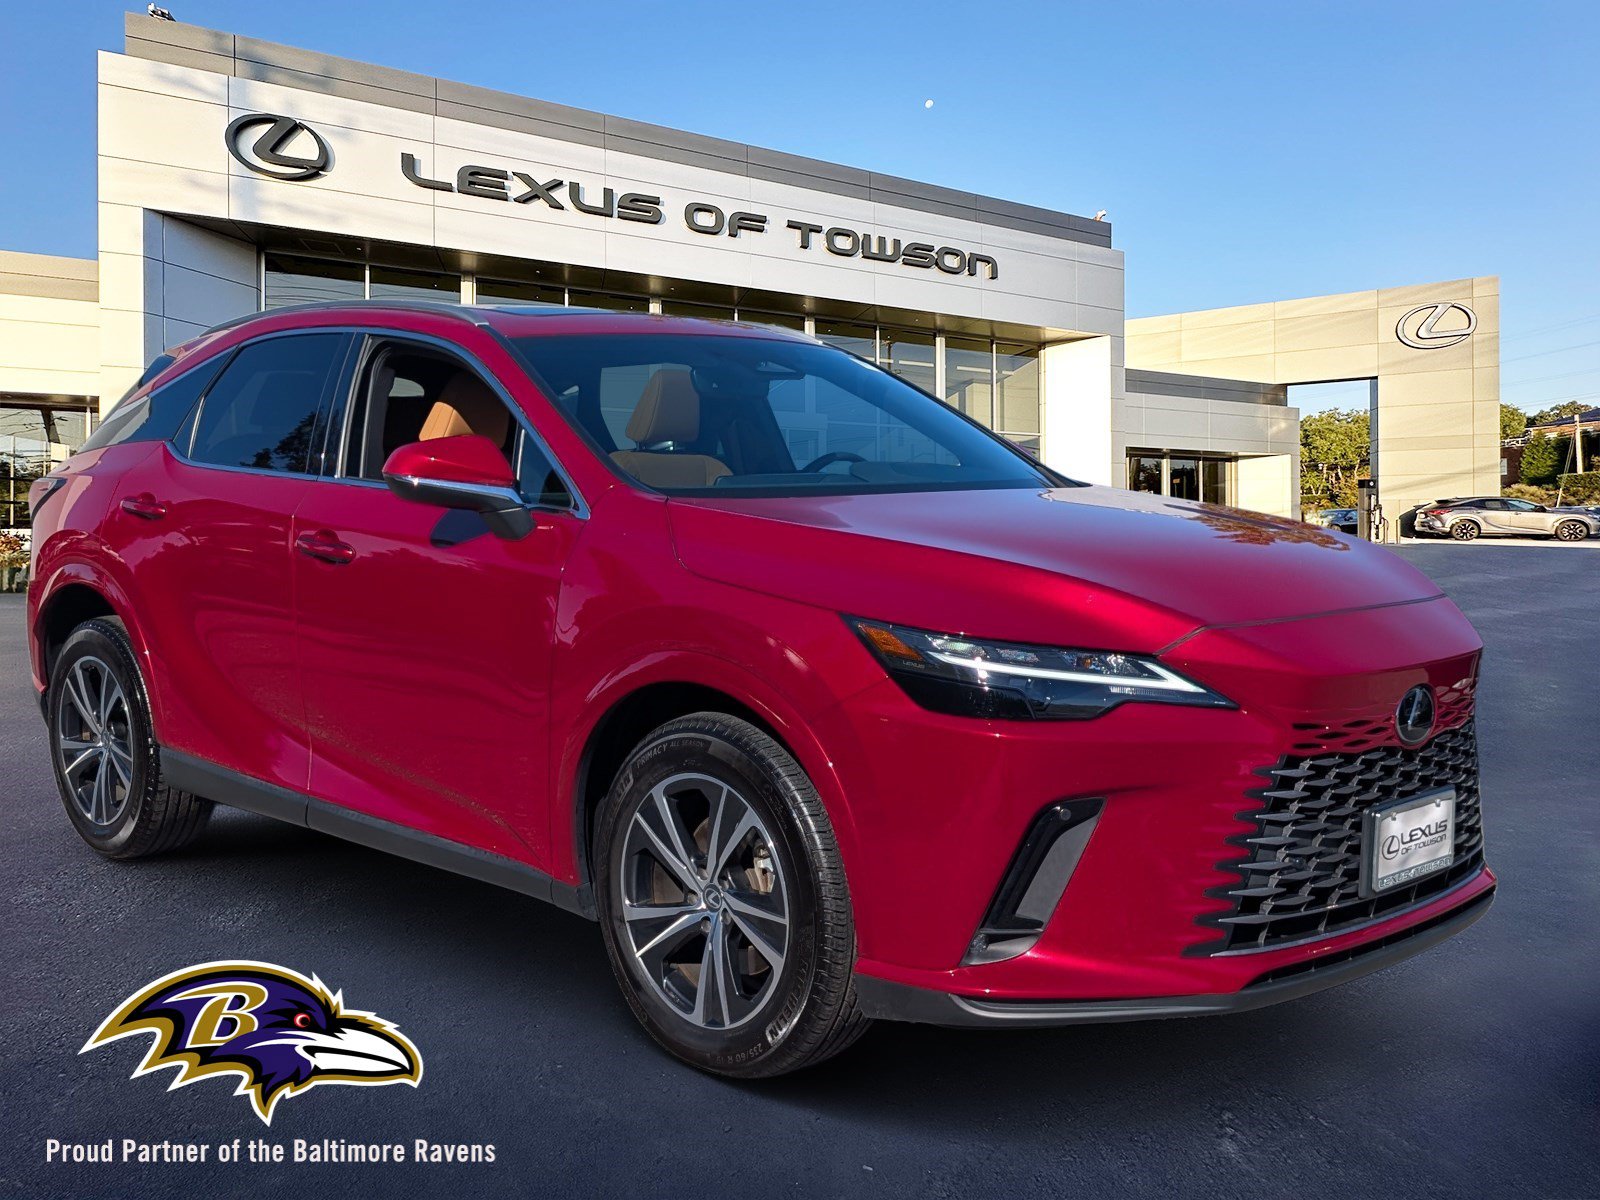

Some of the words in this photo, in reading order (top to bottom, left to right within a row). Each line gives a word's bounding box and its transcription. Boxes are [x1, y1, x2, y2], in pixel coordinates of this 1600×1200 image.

[400, 152, 663, 224] LEXUS
[684, 201, 767, 238] OF
[786, 219, 999, 280] TOWSON
[636, 743, 668, 769] PRIMACY
[1400, 819, 1448, 845] LEXUS
[1401, 847, 1413, 855] OF
[1414, 833, 1447, 849] TOWSON
